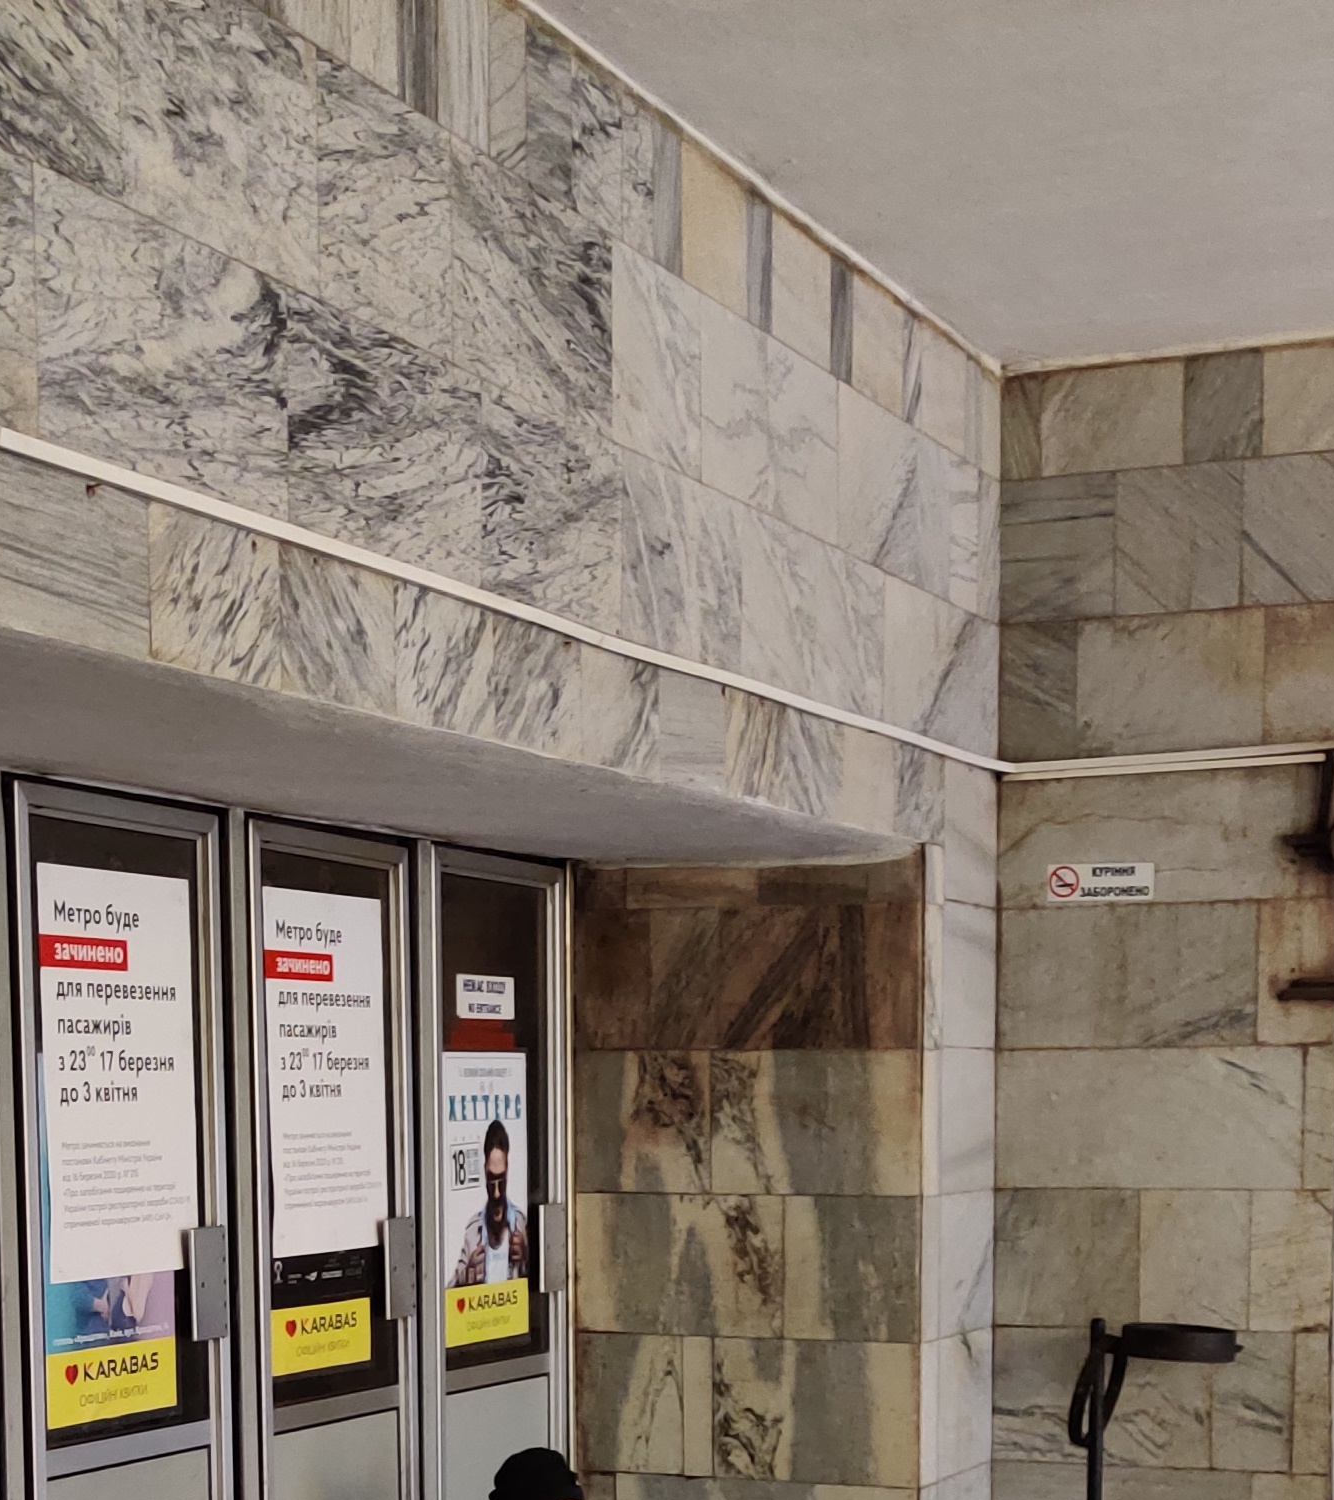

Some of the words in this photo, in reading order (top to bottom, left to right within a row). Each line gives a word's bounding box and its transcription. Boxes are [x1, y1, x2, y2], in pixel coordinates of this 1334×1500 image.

[54, 899, 102, 931] Метро
[105, 904, 140, 934] буде
[276, 919, 313, 947] Метро
[316, 922, 342, 949] буде
[54, 942, 124, 964] зачинено
[276, 956, 330, 976] зачинено
[56, 981, 82, 1001] для
[87, 982, 176, 1006] перевезення
[278, 990, 298, 1008] для
[301, 992, 371, 1013] перевезення
[57, 1013, 132, 1042] пасажирів
[279, 1019, 337, 1045] пасажирів
[100, 1050, 114, 1071] 17
[118, 1049, 175, 1078] березня
[327, 1051, 370, 1077] березня
[60, 1087, 79, 1107] до
[83, 1081, 91, 1102] 3
[95, 1080, 138, 1102] квітня
[282, 1084, 297, 1102] до
[299, 1079, 307, 1098] 3
[309, 1078, 342, 1098] квітня
[452, 1149, 466, 1186] 18
[468, 1289, 518, 1311] KARABAS
[300, 1311, 358, 1336] KARABAS
[83, 1351, 159, 1382] KARABAS
